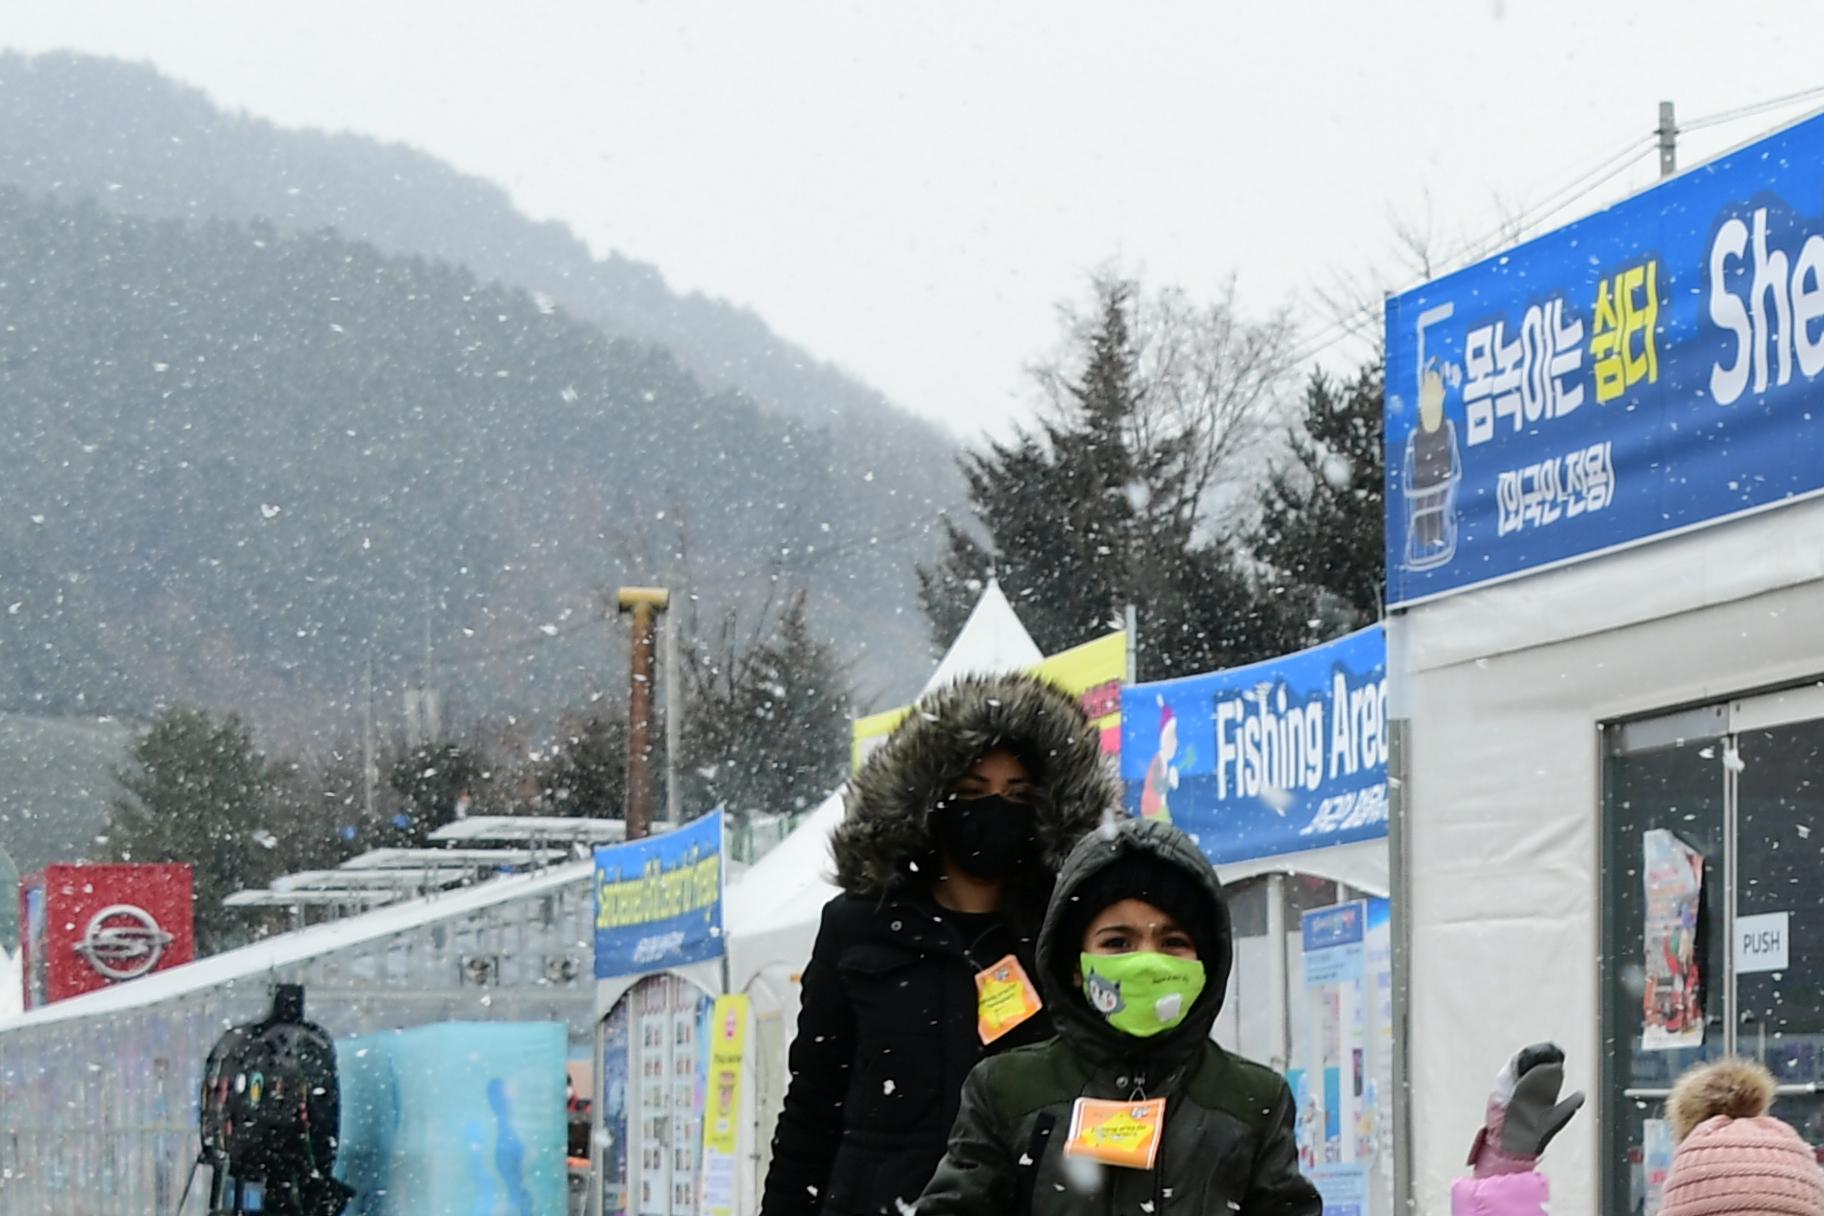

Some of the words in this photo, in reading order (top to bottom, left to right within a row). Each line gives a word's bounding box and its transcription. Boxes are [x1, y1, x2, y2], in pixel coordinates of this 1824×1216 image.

[1463, 298, 1584, 447] 몸녹이는
[1590, 260, 1658, 404] 쉼터
[1216, 681, 1324, 801] Fishing
[1742, 930, 1781, 955] PUSH
